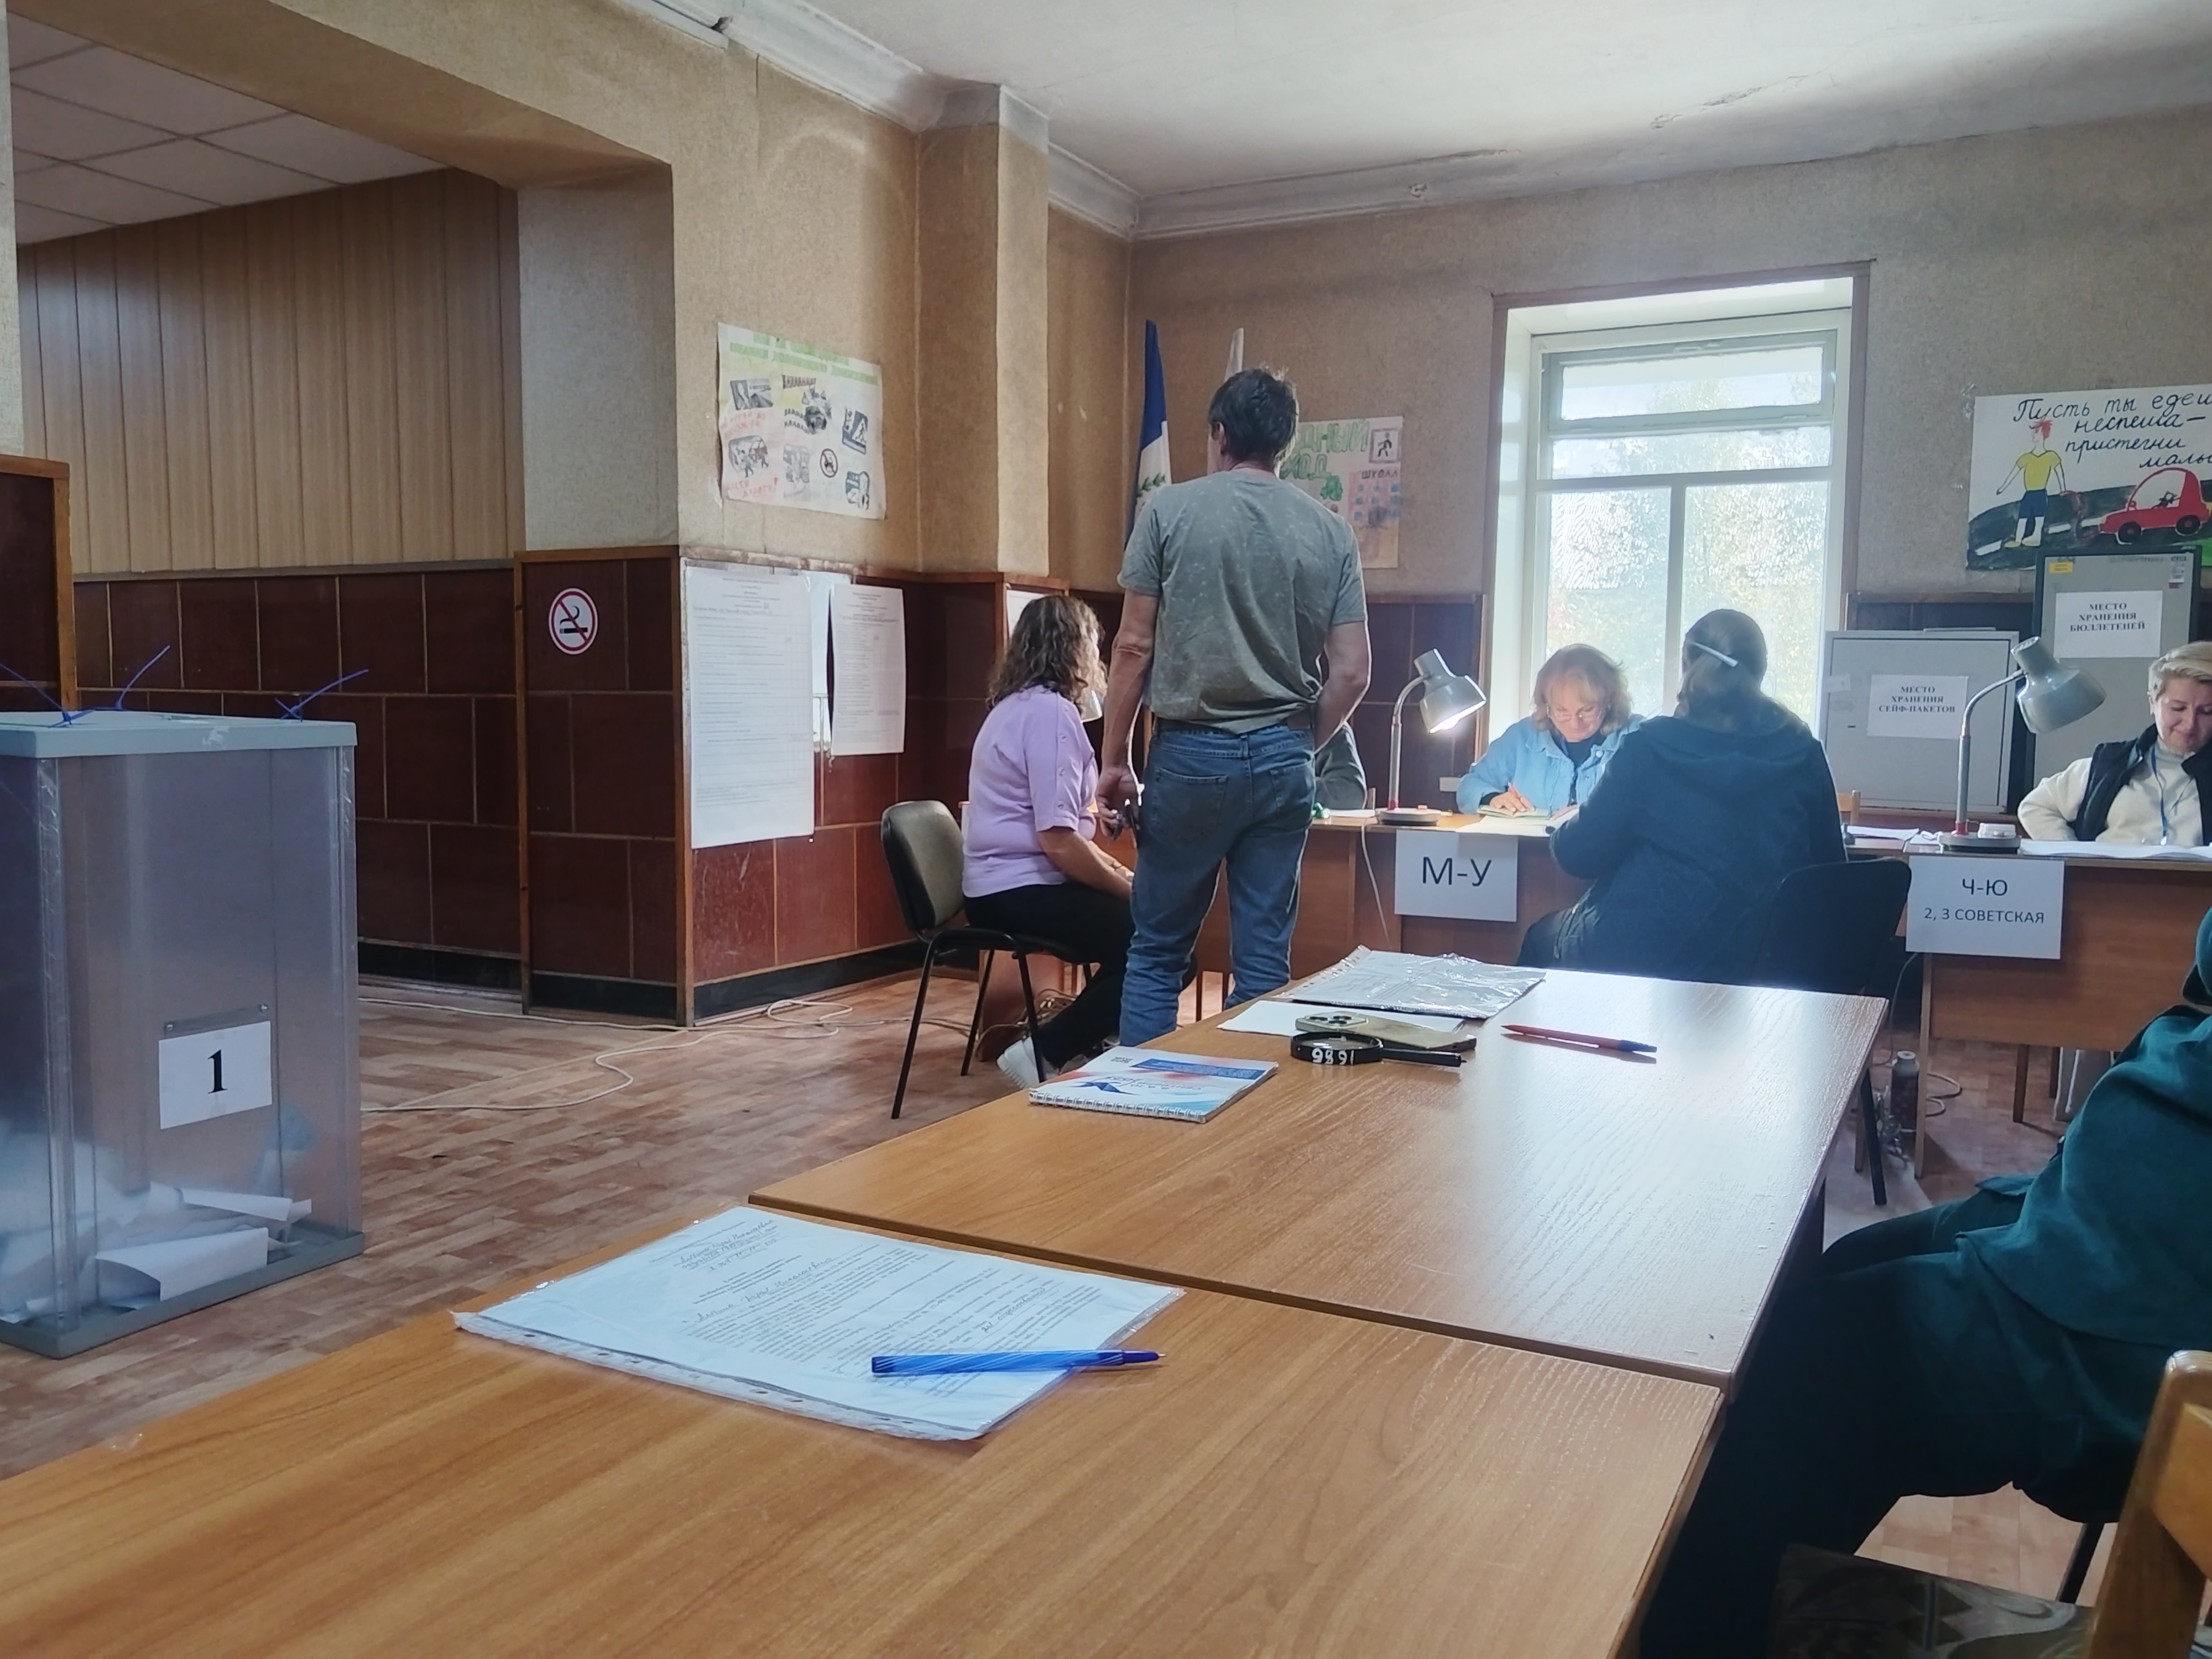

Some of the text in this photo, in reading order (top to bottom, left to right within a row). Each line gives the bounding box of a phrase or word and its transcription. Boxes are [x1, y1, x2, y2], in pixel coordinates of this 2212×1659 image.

[2013, 398, 2090, 429] Пусть
[2104, 398, 2137, 414] ты
[2065, 438, 2186, 463] пристегни
[2089, 603, 2127, 611] МЕСТО
[2079, 613, 2137, 622] ХРАНЕНИЯ
[2070, 622, 2146, 632] БЮЛЛЕТЕНЕЙ
[1879, 704, 1955, 713] СЕЙФ-ПАКЕТОВ
[1422, 857, 1492, 887] М-У
[1962, 878, 2008, 896] Ч-Ю
[1942, 908, 1950, 920] 3
[1955, 909, 2044, 924] СОВЕТСКАЯ
[207, 1049, 228, 1094] 1
